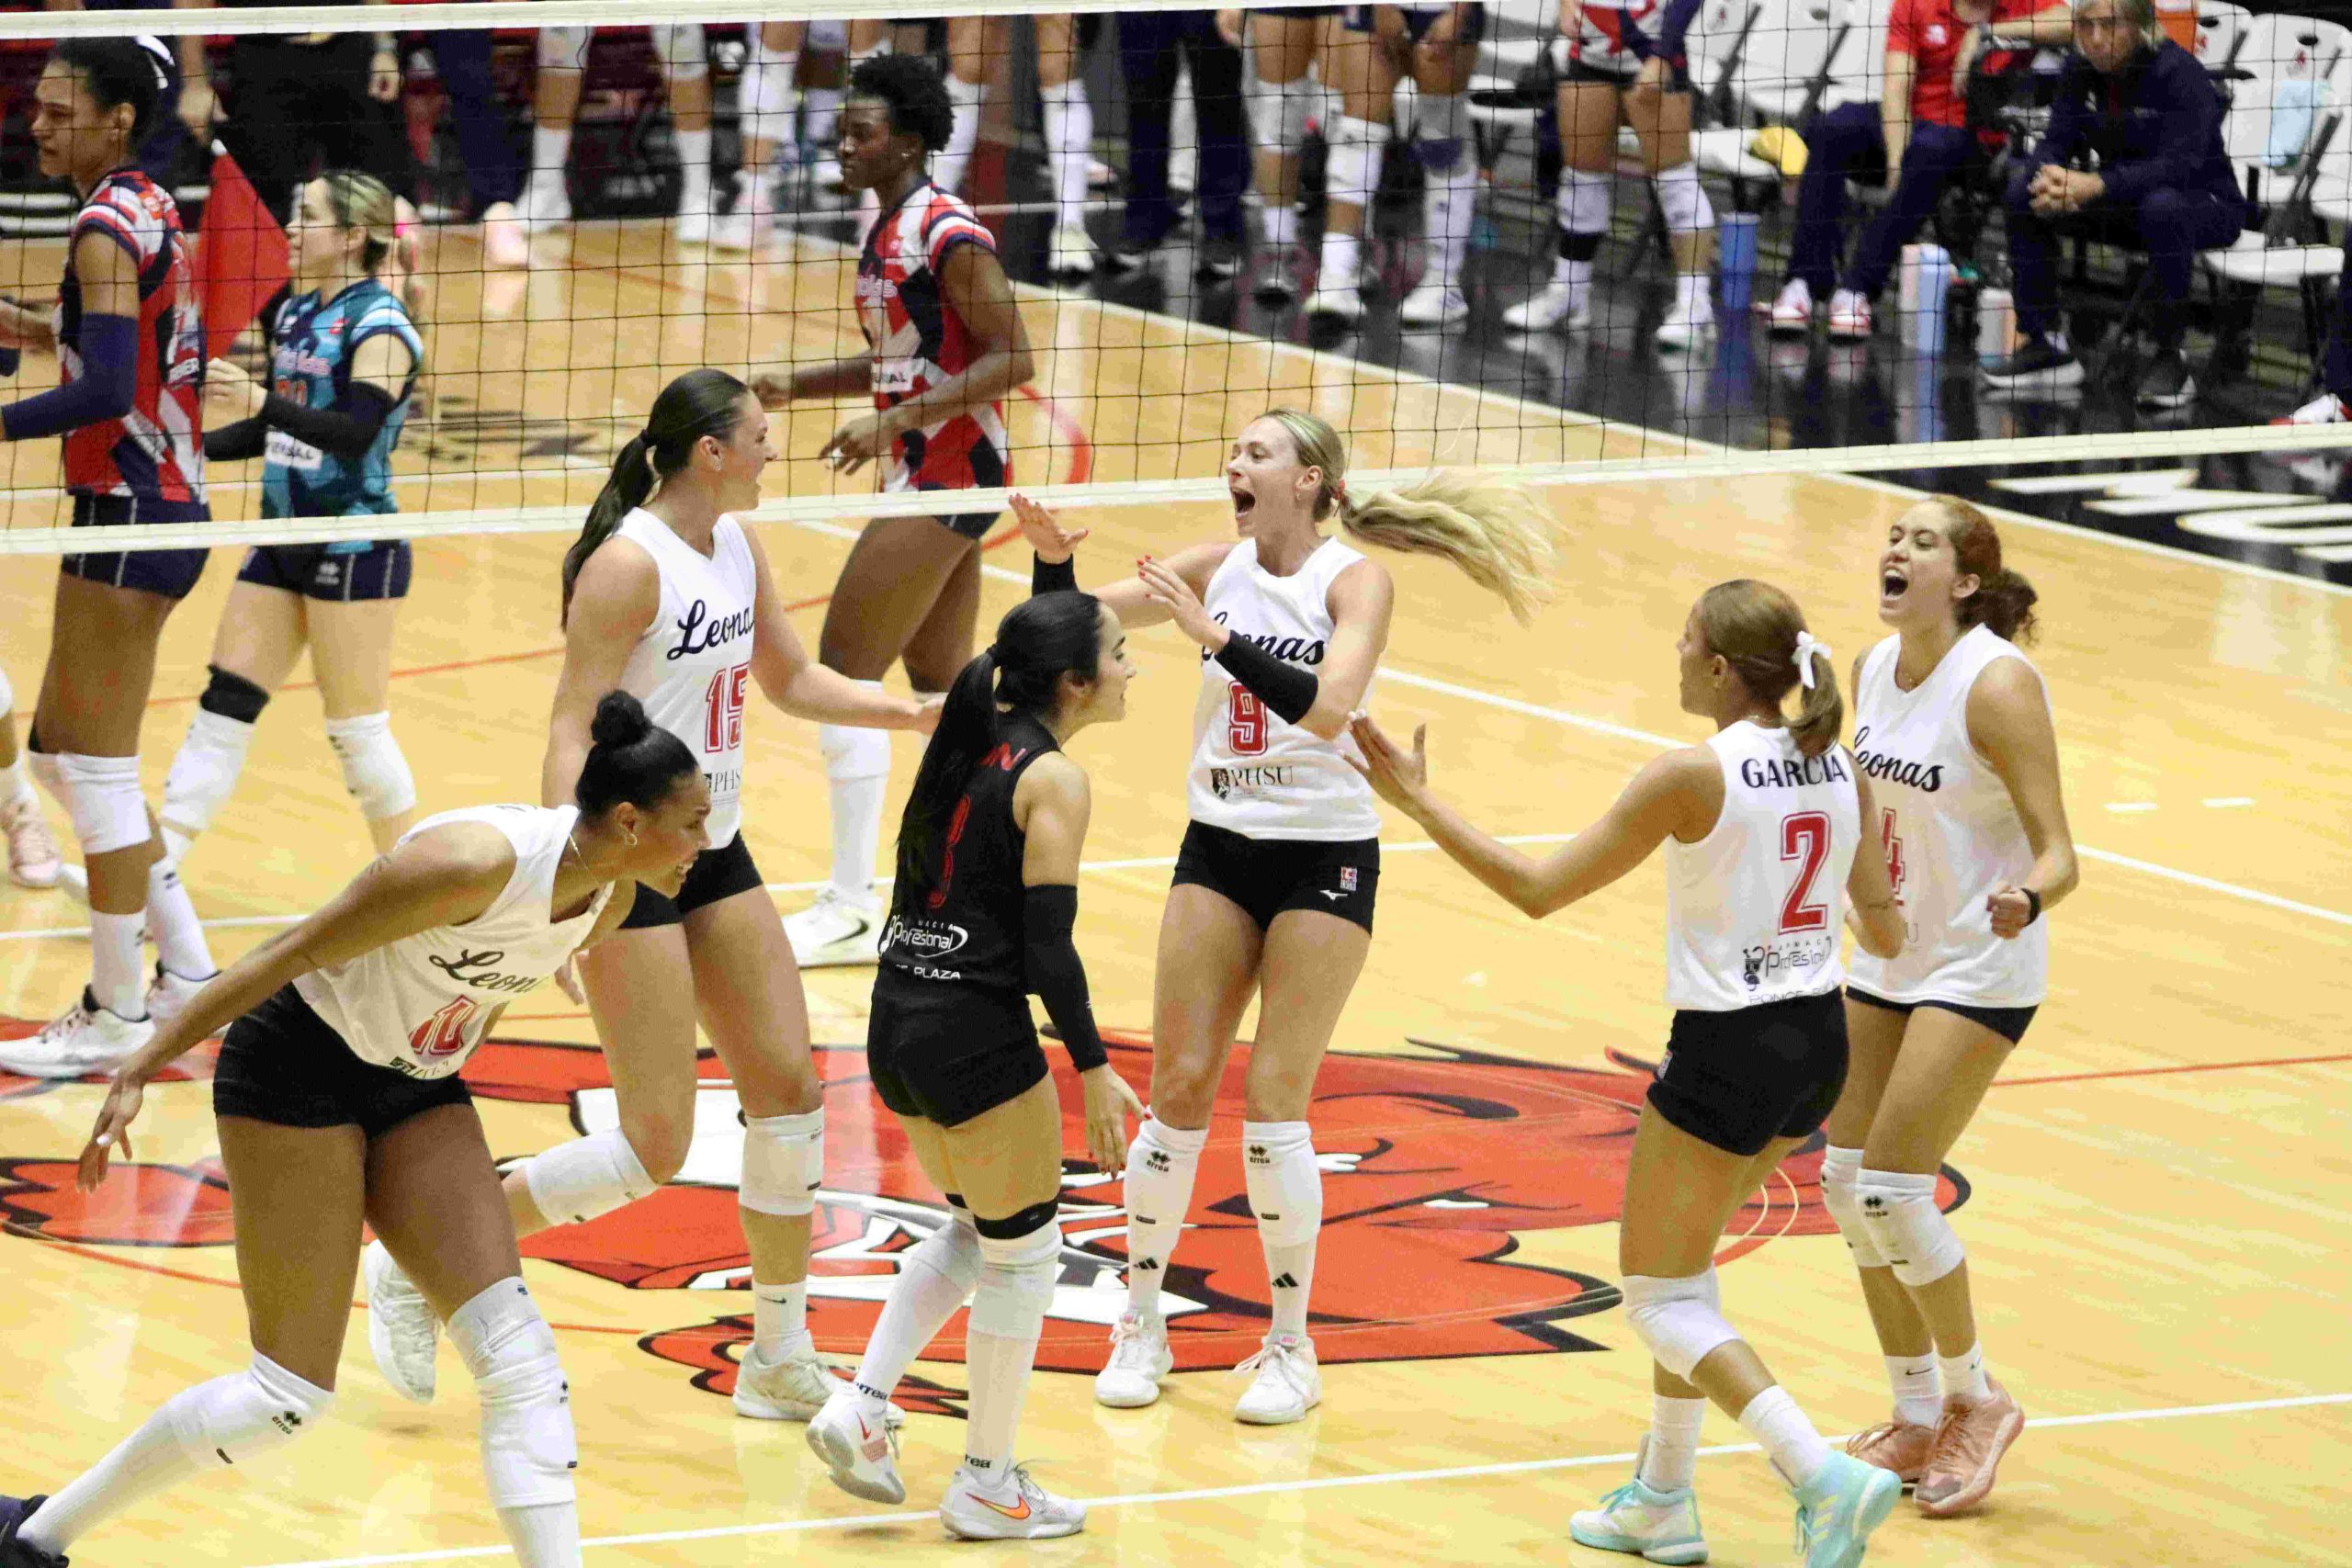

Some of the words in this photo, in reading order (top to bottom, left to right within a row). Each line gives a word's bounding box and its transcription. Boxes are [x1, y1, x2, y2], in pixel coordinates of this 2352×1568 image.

[705, 660, 751, 753] 15
[1228, 680, 1268, 756] 9
[1229, 766, 1294, 787] PHSU
[1741, 754, 1848, 789] GARCIA
[1778, 810, 1832, 936] 2
